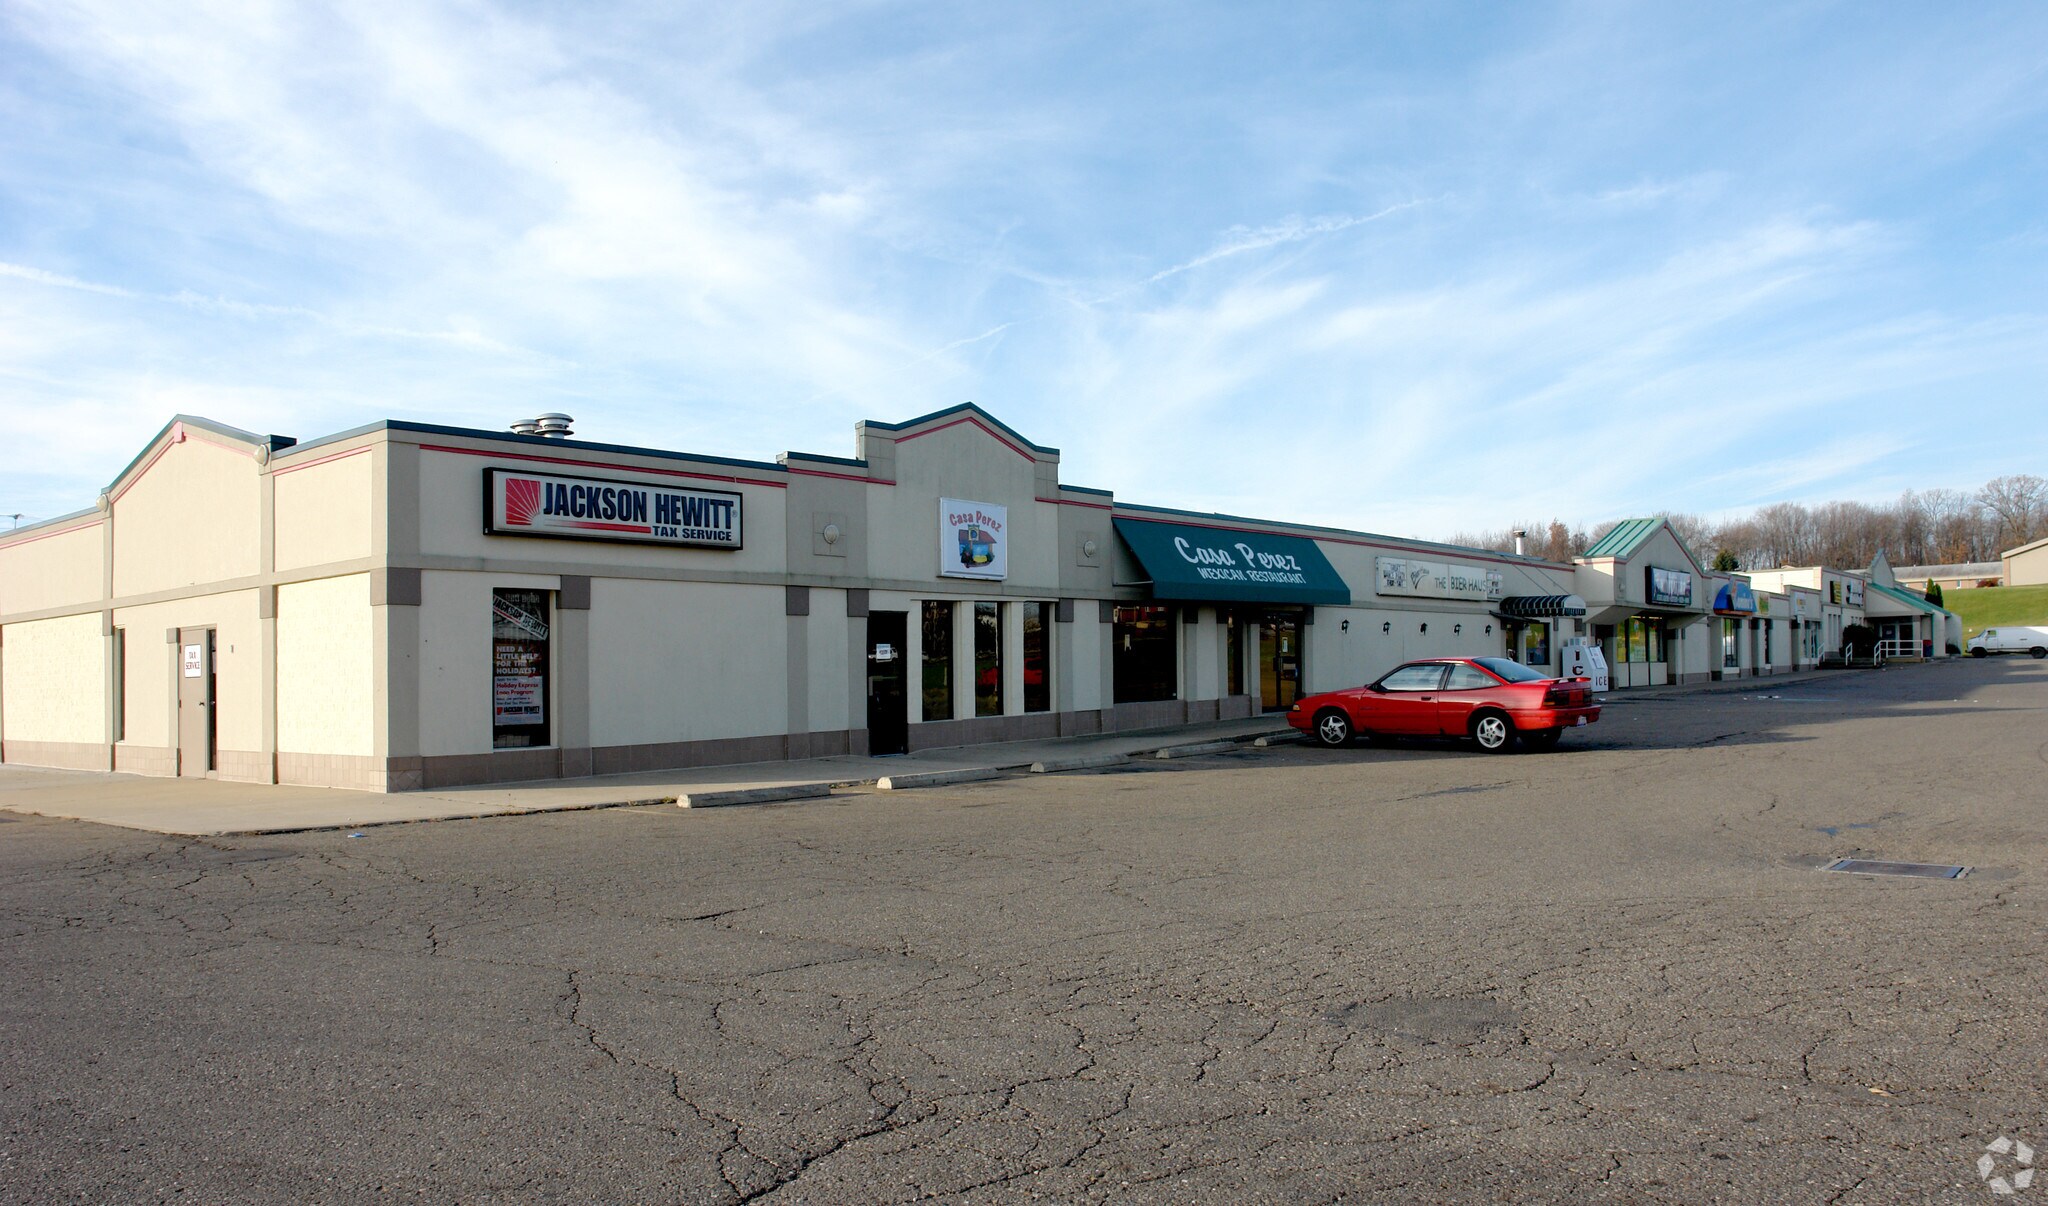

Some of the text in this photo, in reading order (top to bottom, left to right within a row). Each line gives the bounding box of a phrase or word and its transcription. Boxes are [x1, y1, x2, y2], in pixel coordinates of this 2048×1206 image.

[543, 482, 734, 529] JACKSON HEWITT
[949, 510, 1002, 532] Casa Perez
[652, 525, 732, 541] TAX SERVICE
[1174, 536, 1302, 571] Casa Perez
[1197, 567, 1307, 584] MEXICAN RESTAURANT
[1434, 577, 1447, 590] THE
[1450, 576, 1467, 591] BIER
[1468, 577, 1487, 592] HAUS
[494, 597, 523, 620] JACKSON
[186, 661, 200, 669] SERVICE
[1595, 676, 1608, 686] ICE
